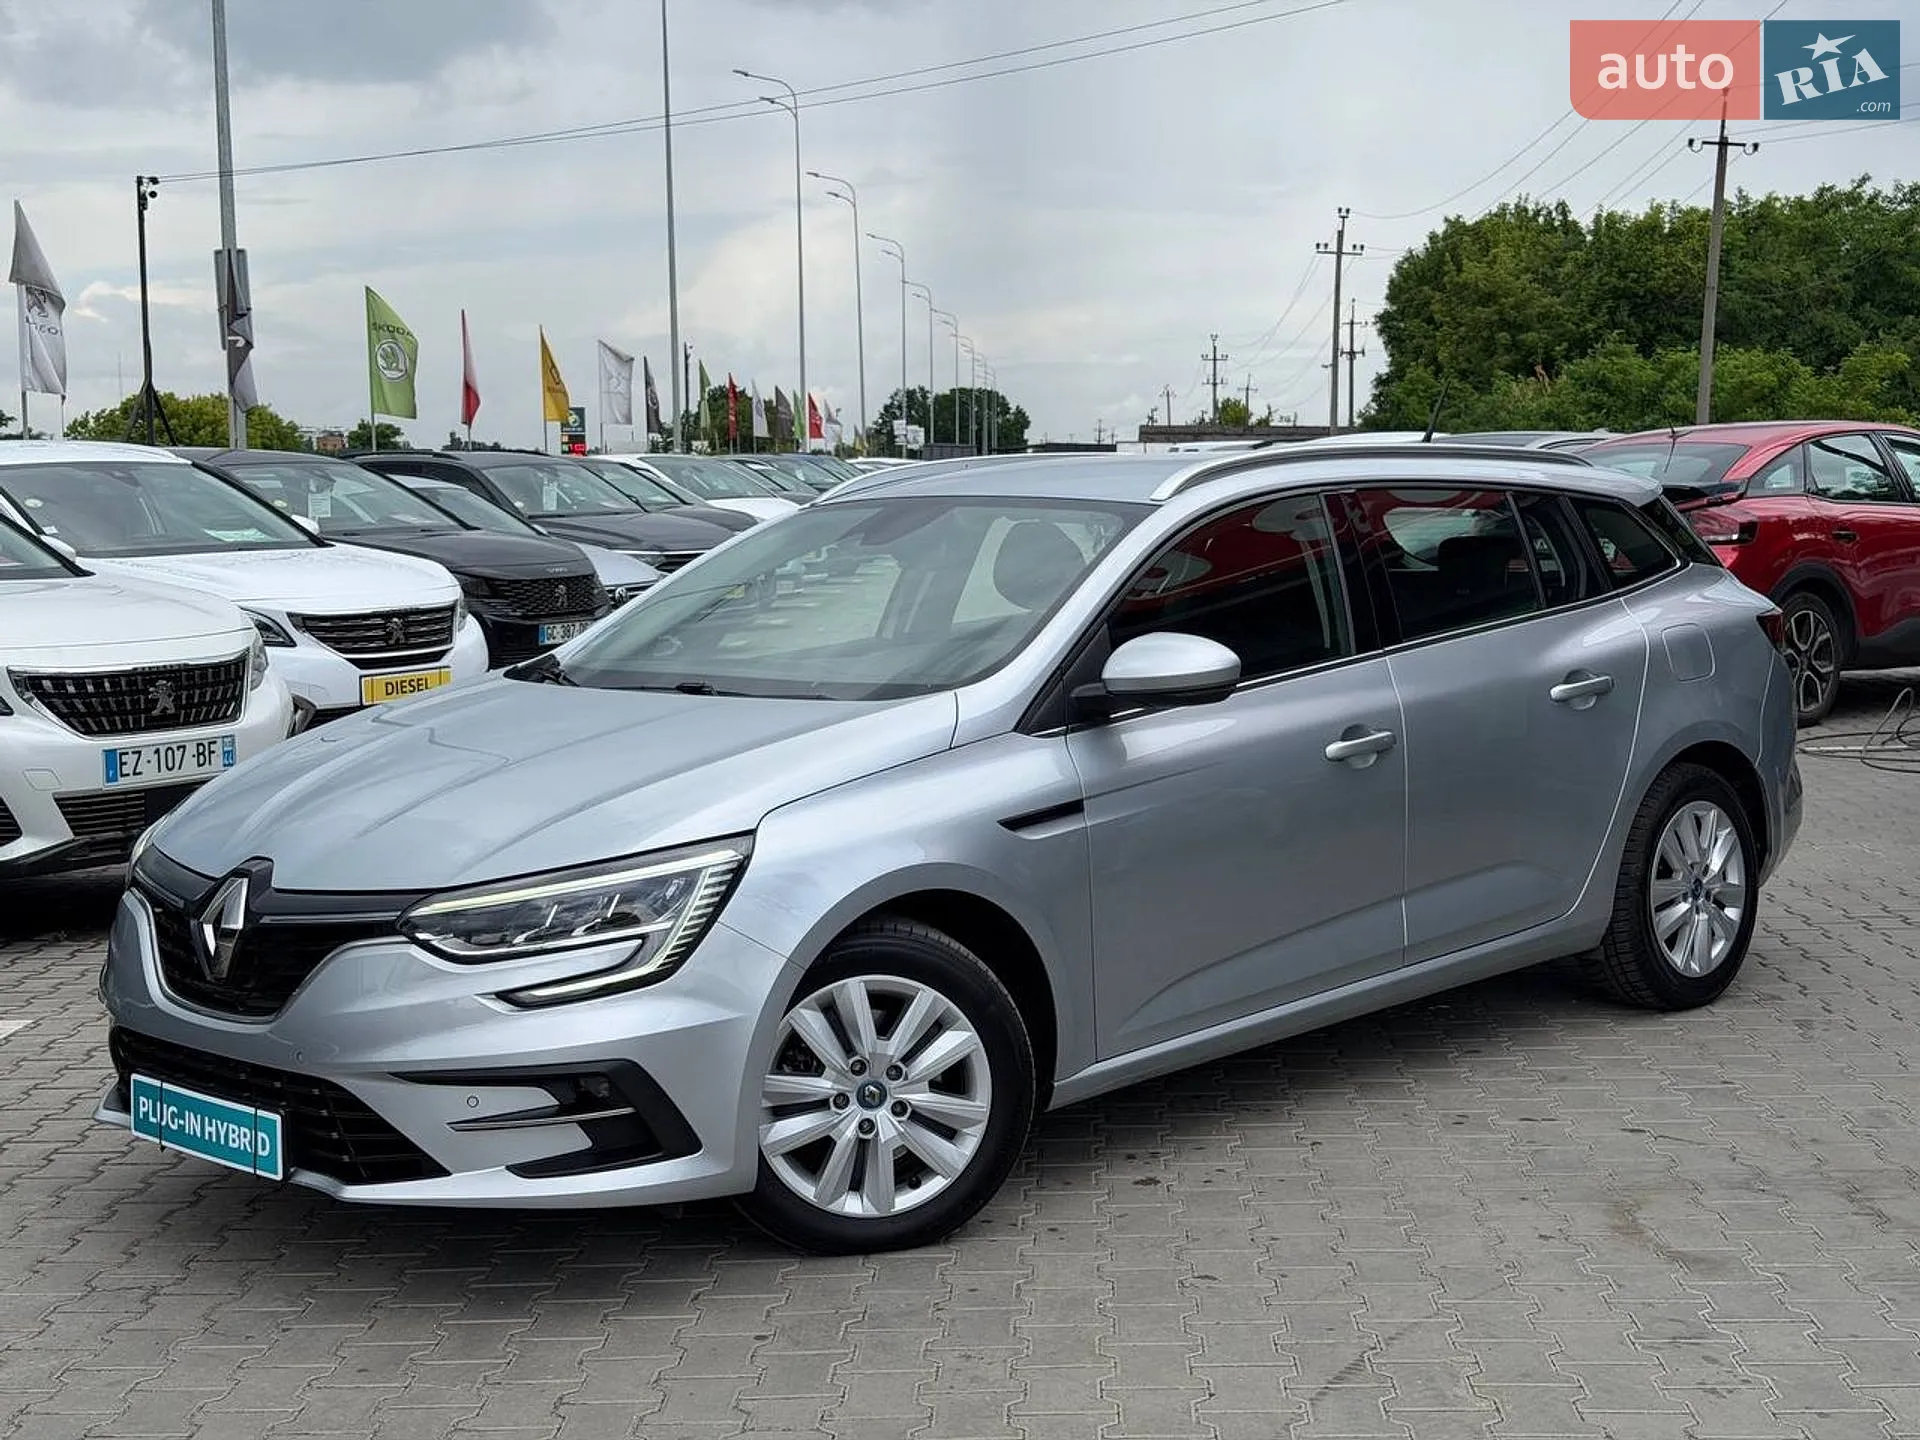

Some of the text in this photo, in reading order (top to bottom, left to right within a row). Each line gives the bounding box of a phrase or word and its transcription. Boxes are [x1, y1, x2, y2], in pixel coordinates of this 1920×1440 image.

[384, 677, 430, 696] DIESEL
[139, 1095, 270, 1157] PLUG-IN HYBRID
